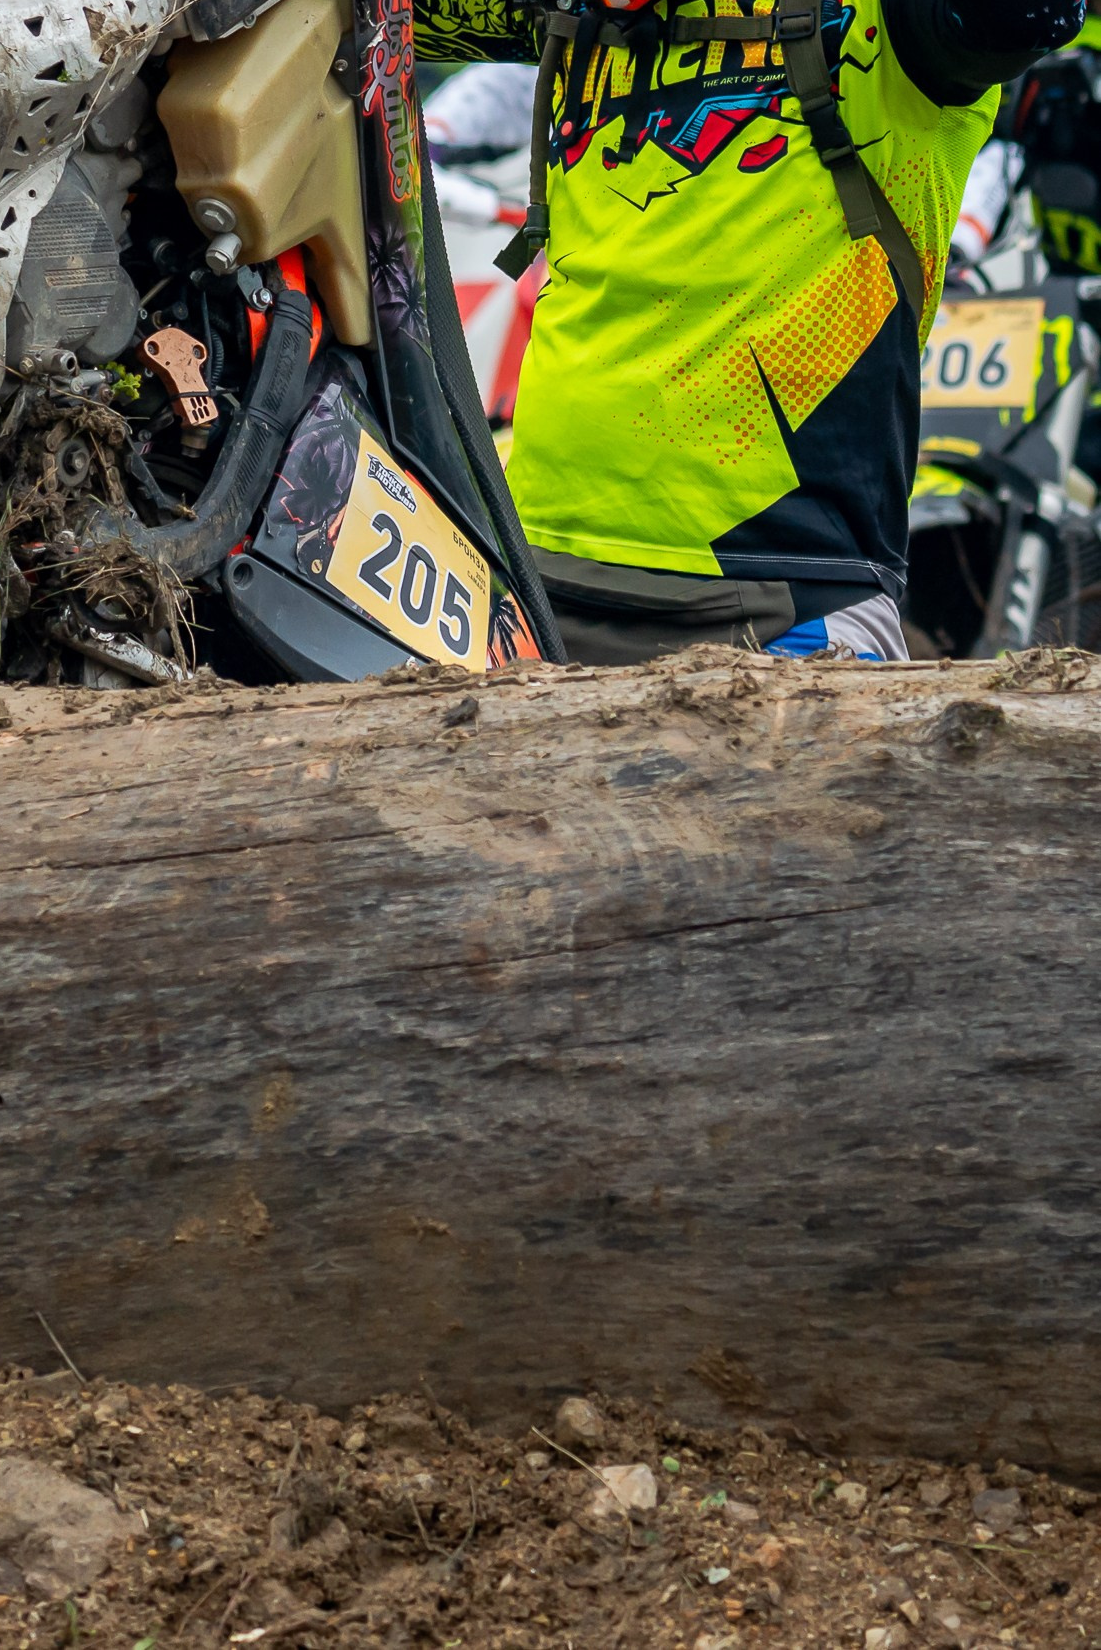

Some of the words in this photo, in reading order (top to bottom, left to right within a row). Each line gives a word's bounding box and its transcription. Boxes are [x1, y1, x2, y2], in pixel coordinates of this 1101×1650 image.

[703, 79, 719, 88] THE
[720, 76, 739, 85] ART
[741, 75, 755, 83] OF
[452, 531, 486, 576] БРОНЗА
[358, 511, 472, 658] 205
